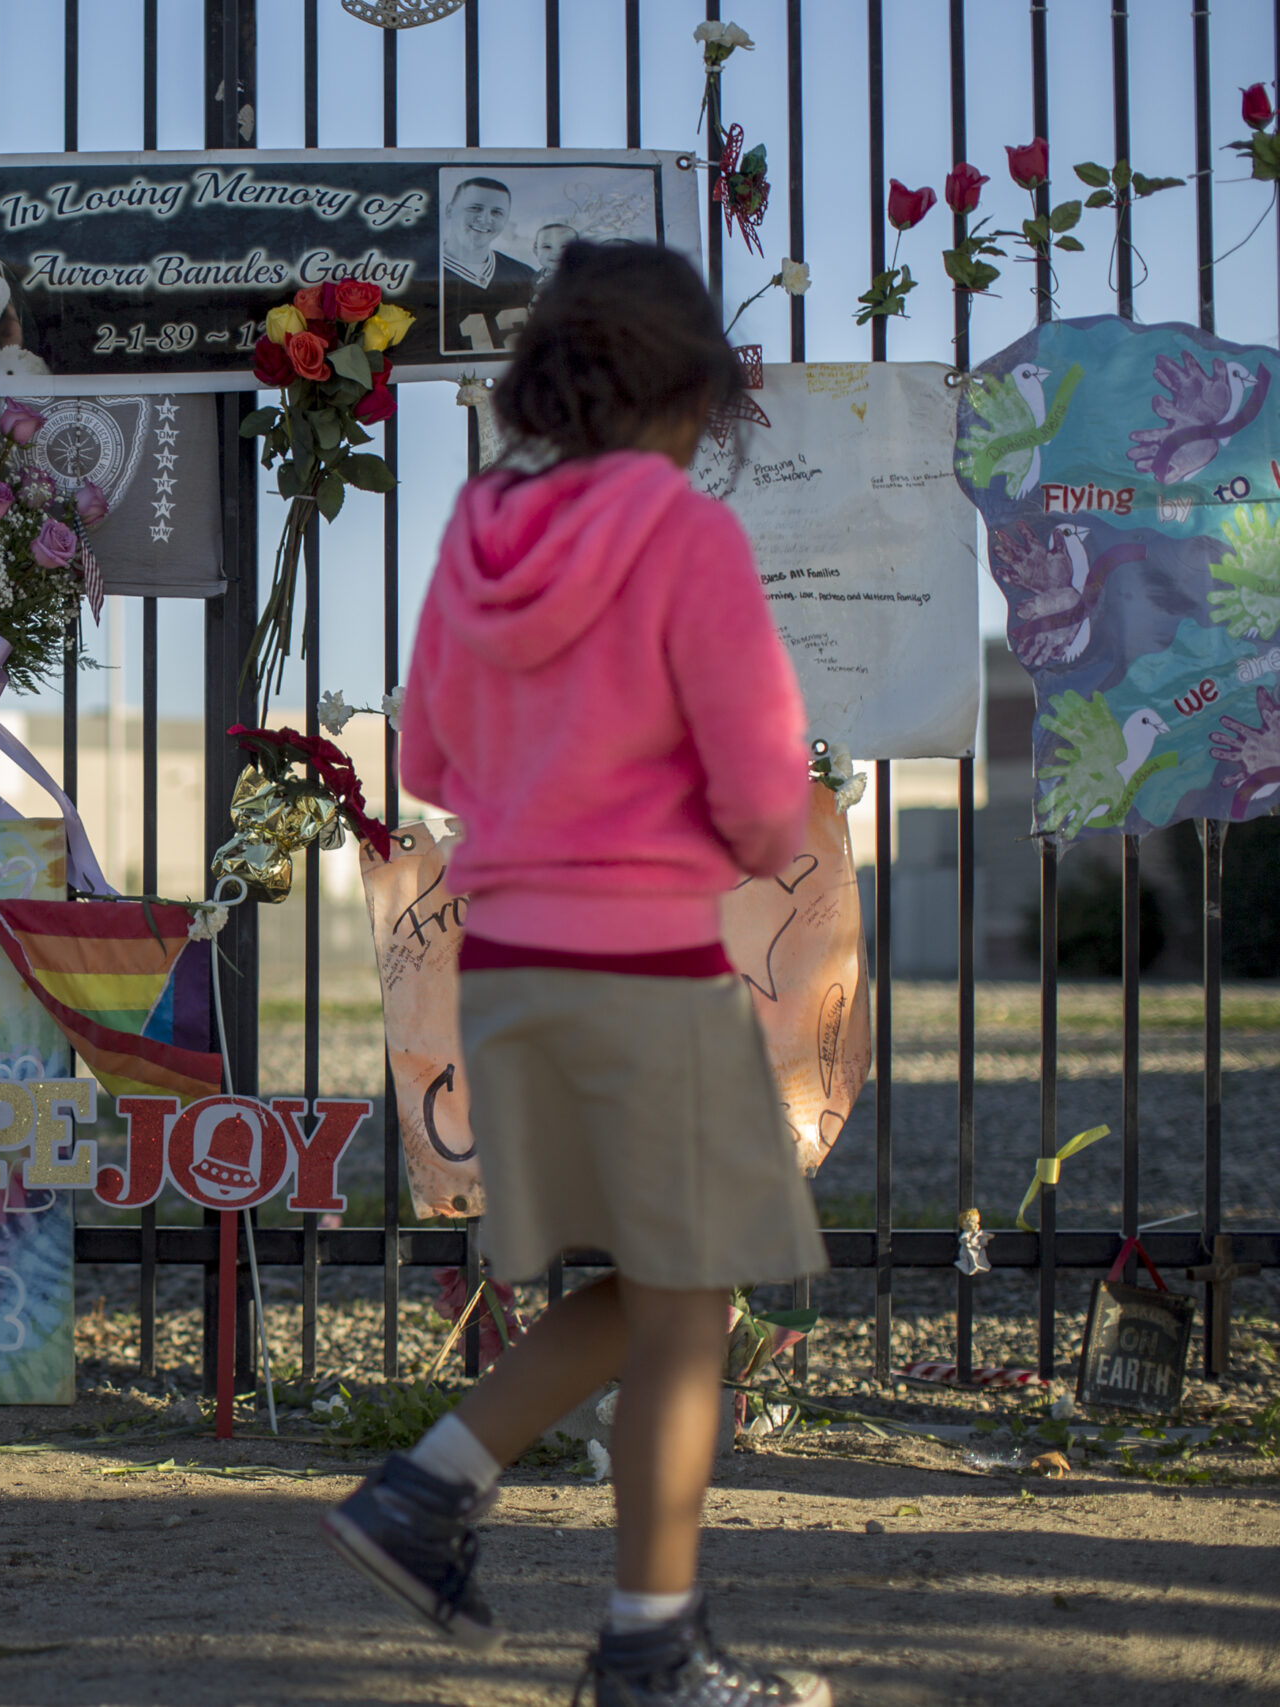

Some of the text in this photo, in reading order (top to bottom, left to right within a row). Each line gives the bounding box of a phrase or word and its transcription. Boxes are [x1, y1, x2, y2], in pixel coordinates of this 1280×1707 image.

[1, 193, 45, 228] In
[50, 178, 183, 218] Loving
[194, 171, 353, 218] Memory
[25, 248, 413, 294] Aurora Banales Godoy
[94, 322, 196, 353] 2-1-89
[236, 319, 267, 350] 1
[92, 419, 113, 463] ELECTRICAL
[754, 459, 795, 476] Praying
[1041, 475, 1251, 524] Flying by to
[1173, 651, 1280, 717] we are
[95, 1098, 372, 1210] JOY
[1096, 1353, 1170, 1396] EARTH
